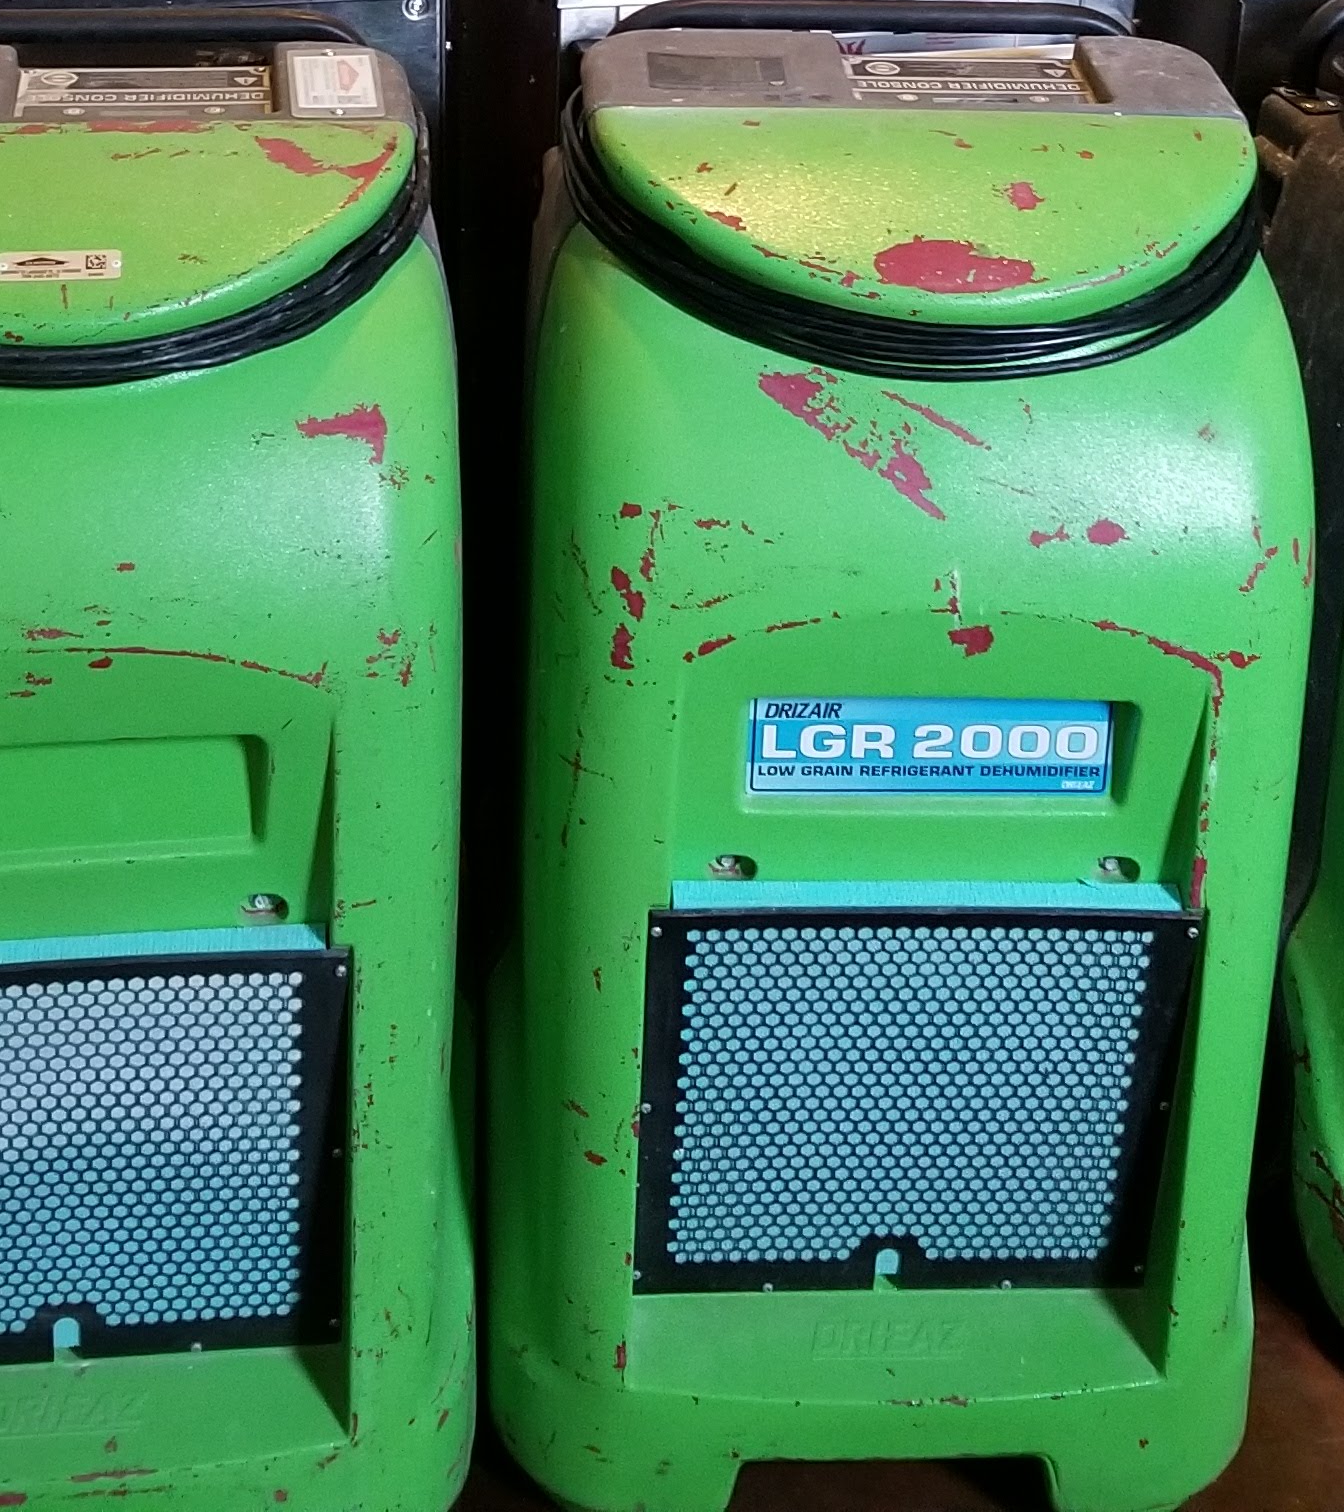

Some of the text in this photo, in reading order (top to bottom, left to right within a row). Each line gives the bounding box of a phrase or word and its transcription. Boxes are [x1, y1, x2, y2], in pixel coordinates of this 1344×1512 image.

[857, 79, 1081, 91] DEHUMIDIFIER CONSOLE
[123, 91, 265, 101] DEHUMIDIFIER
[764, 702, 843, 719] DRIZAIR
[761, 723, 1100, 760] LGR 2000
[757, 765, 1101, 777] LOW GRAIN REFRIGERANT DEHUMIDIFIER
